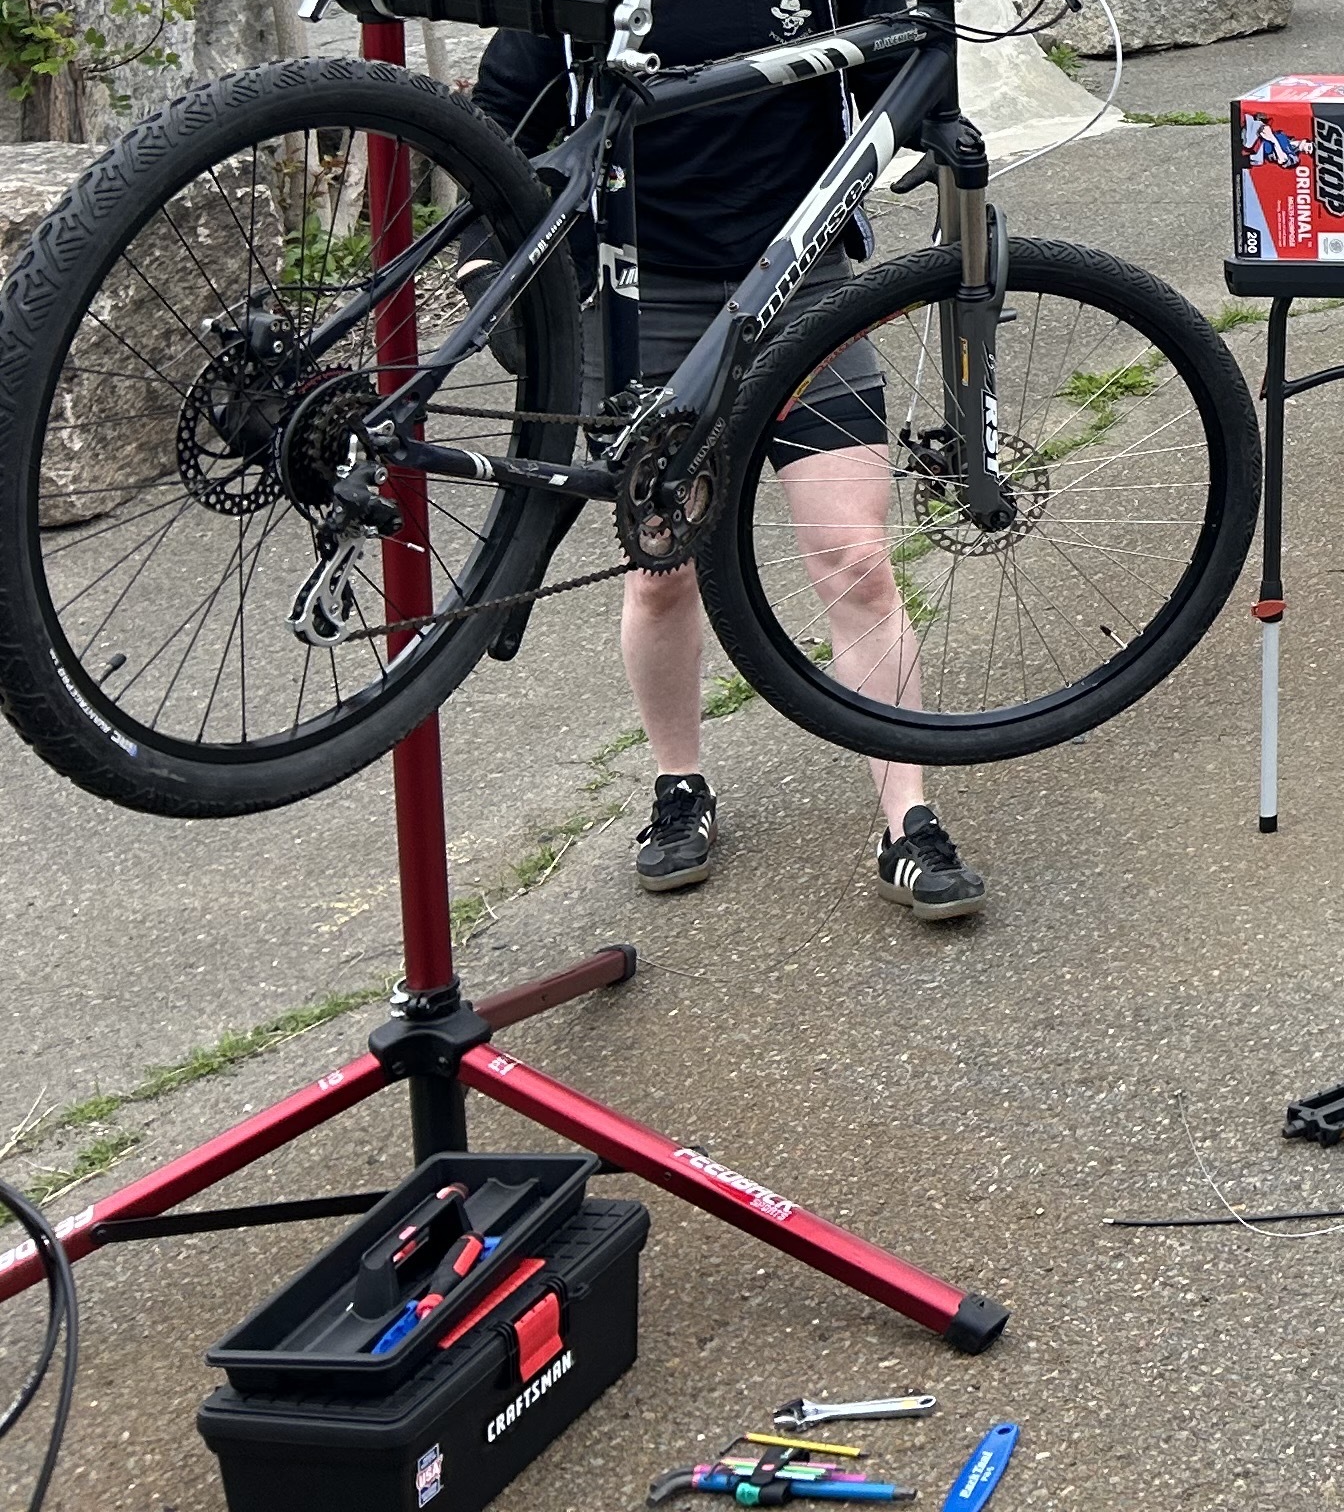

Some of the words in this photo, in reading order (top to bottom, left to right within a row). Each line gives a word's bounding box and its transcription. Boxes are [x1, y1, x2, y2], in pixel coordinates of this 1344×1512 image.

[1246, 232, 1258, 254] 200
[1295, 166, 1313, 243] ORIGINAL
[984, 393, 1000, 479] RST
[487, 1350, 573, 1443] CRAFTSMAN
[418, 1461, 441, 1489] USA
